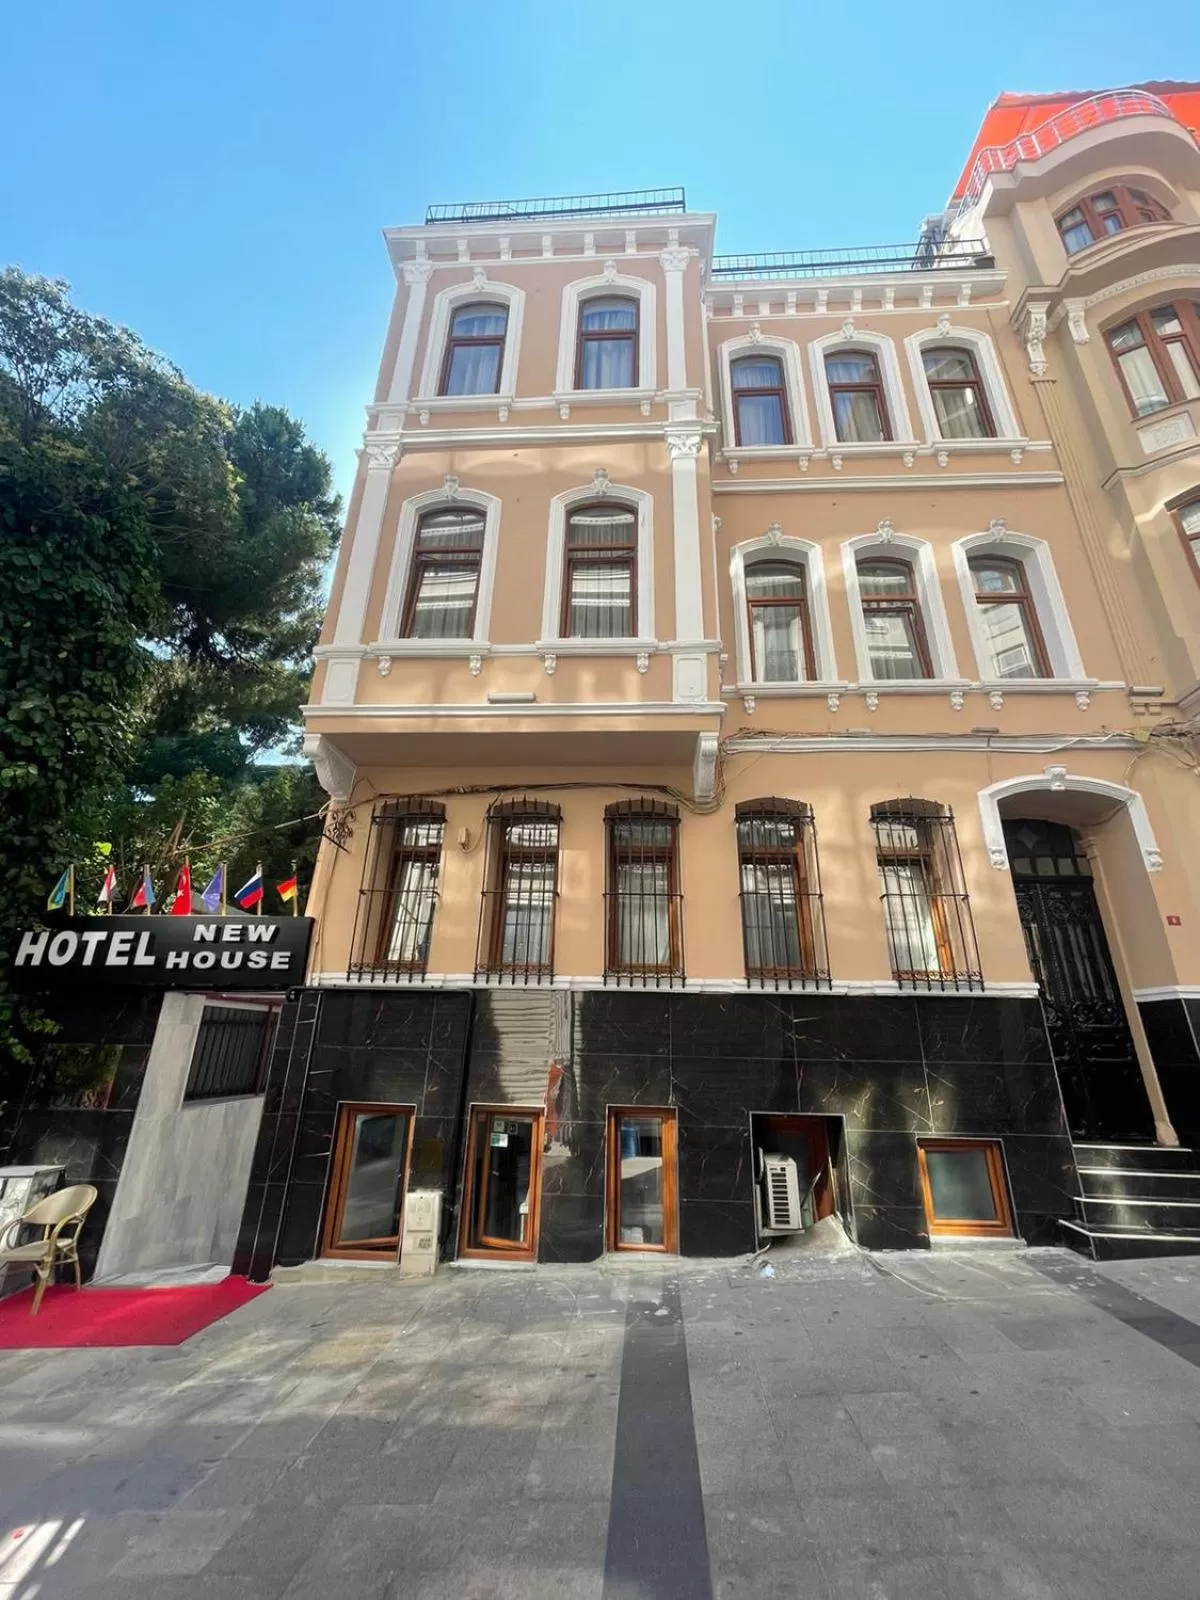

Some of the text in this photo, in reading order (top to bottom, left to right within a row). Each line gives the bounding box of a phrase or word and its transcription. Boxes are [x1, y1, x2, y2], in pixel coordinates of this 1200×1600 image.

[193, 924, 277, 942] NEW
[14, 930, 156, 966] HOTEL
[165, 950, 291, 970] HOUSE
